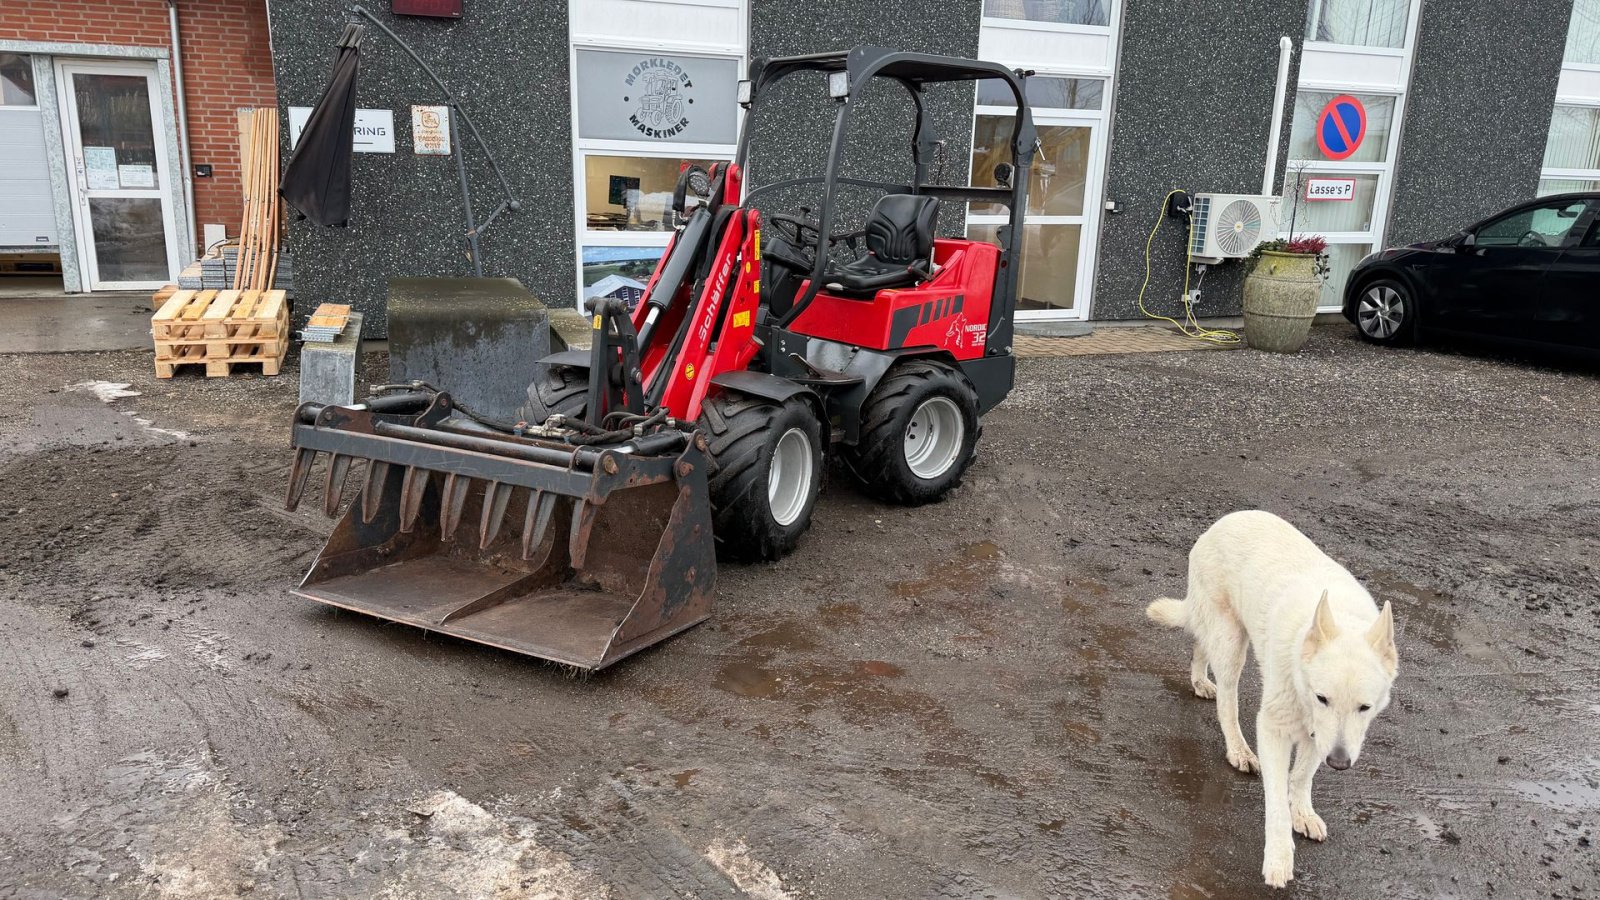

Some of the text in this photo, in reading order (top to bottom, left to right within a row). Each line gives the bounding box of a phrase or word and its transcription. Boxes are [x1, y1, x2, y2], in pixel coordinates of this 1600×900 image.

[629, 113, 690, 138] MASKINER
[1309, 184, 1351, 195] Lasse's P
[699, 252, 732, 344] Schäffer
[972, 332, 986, 343] 32
